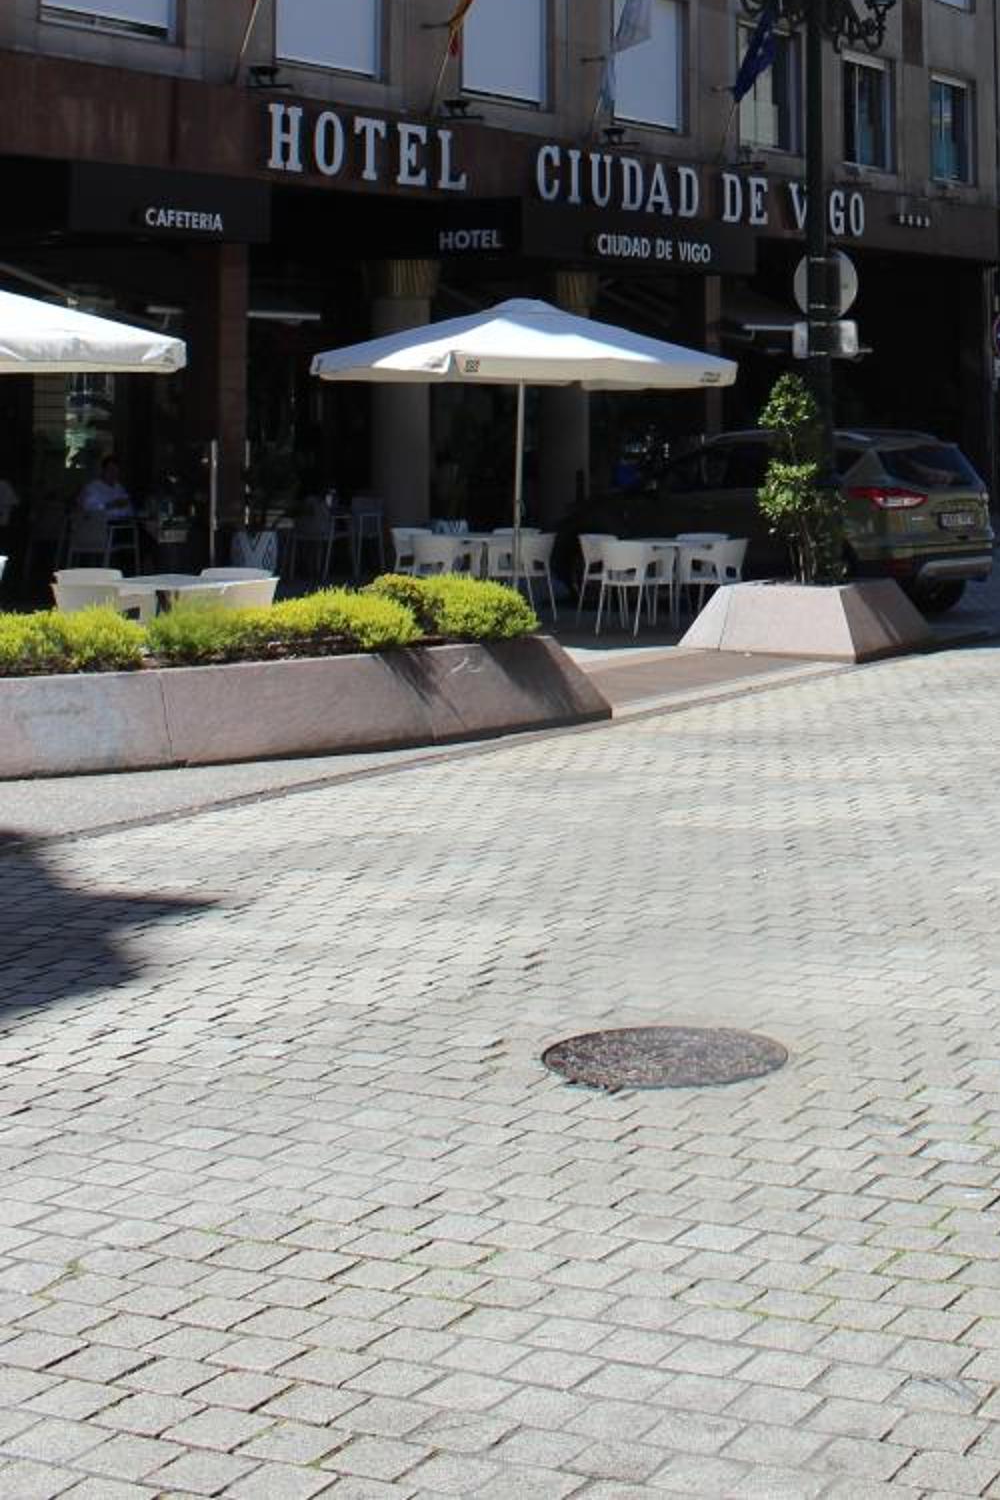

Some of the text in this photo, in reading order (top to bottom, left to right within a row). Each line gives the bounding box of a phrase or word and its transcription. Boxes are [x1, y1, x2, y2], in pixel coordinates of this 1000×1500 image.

[268, 103, 865, 237] HOTEL CIUDAD DE VGO
[439, 229, 503, 250] HOTEL
[597, 233, 711, 263] CIUDAD DE VIGO
